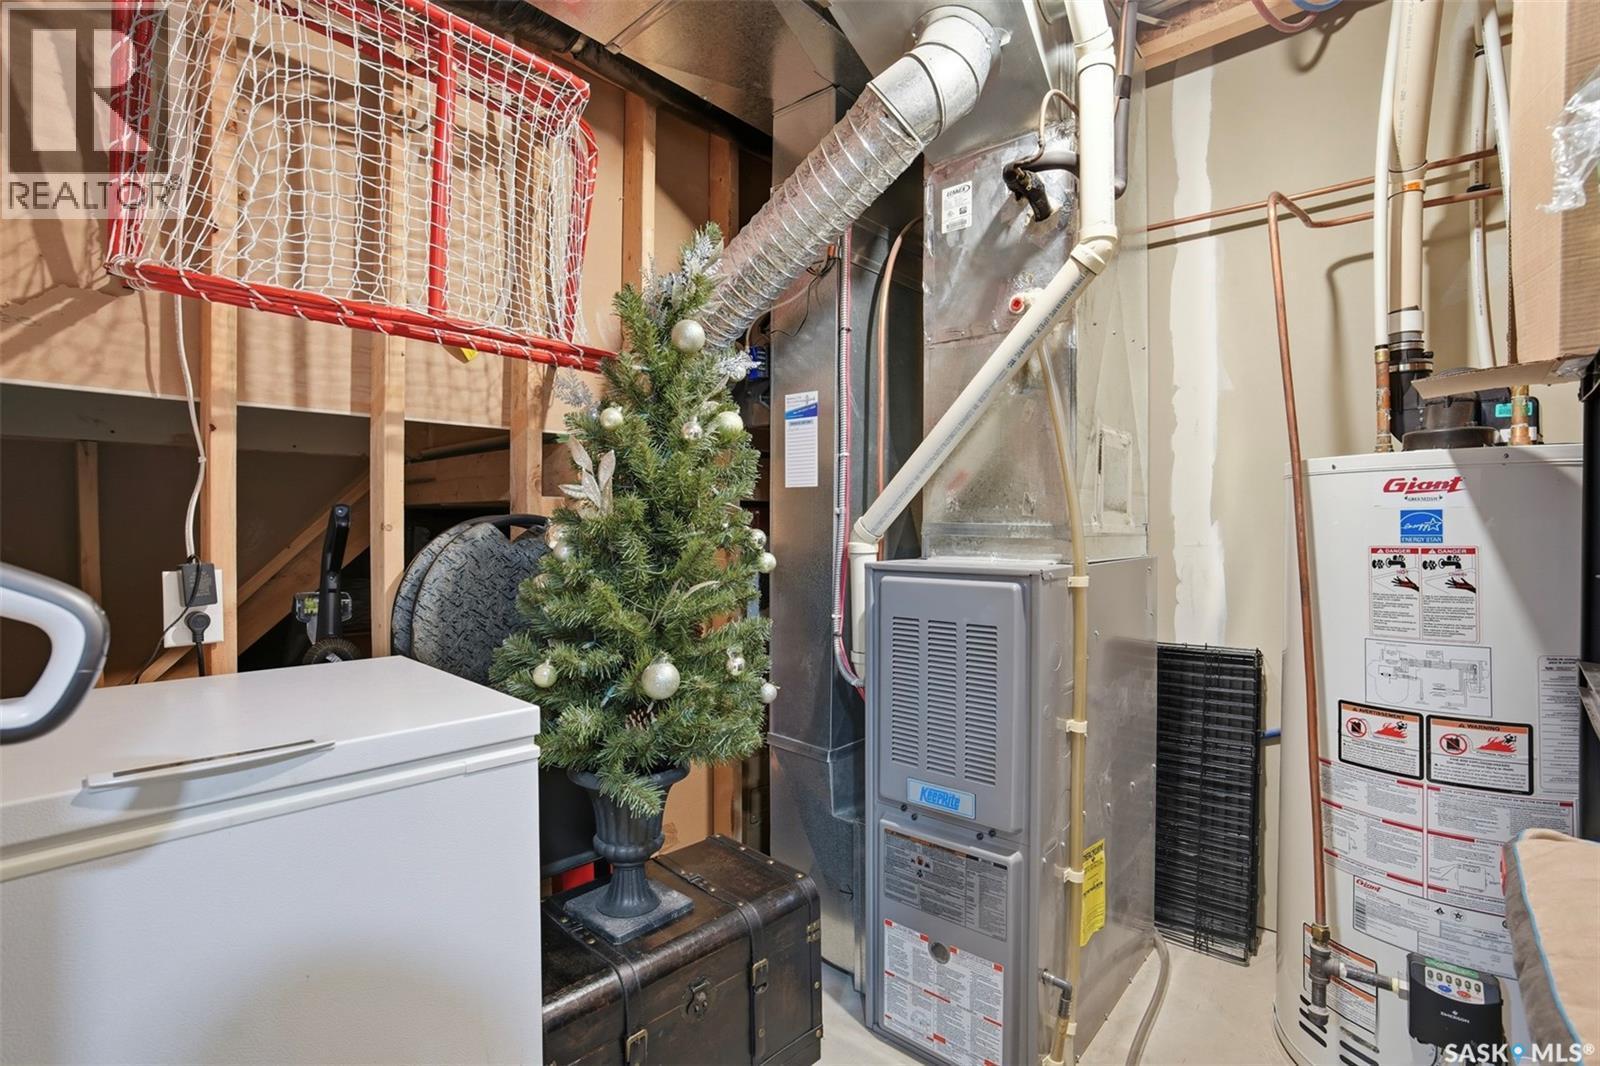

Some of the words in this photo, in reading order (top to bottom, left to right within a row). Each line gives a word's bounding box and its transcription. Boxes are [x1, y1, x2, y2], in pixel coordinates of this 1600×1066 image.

[1383, 476, 1465, 494] Giant
[1467, 723, 1501, 732] WARNING
[920, 786, 961, 811] KeepRite
[1355, 878, 1381, 892] Giant
